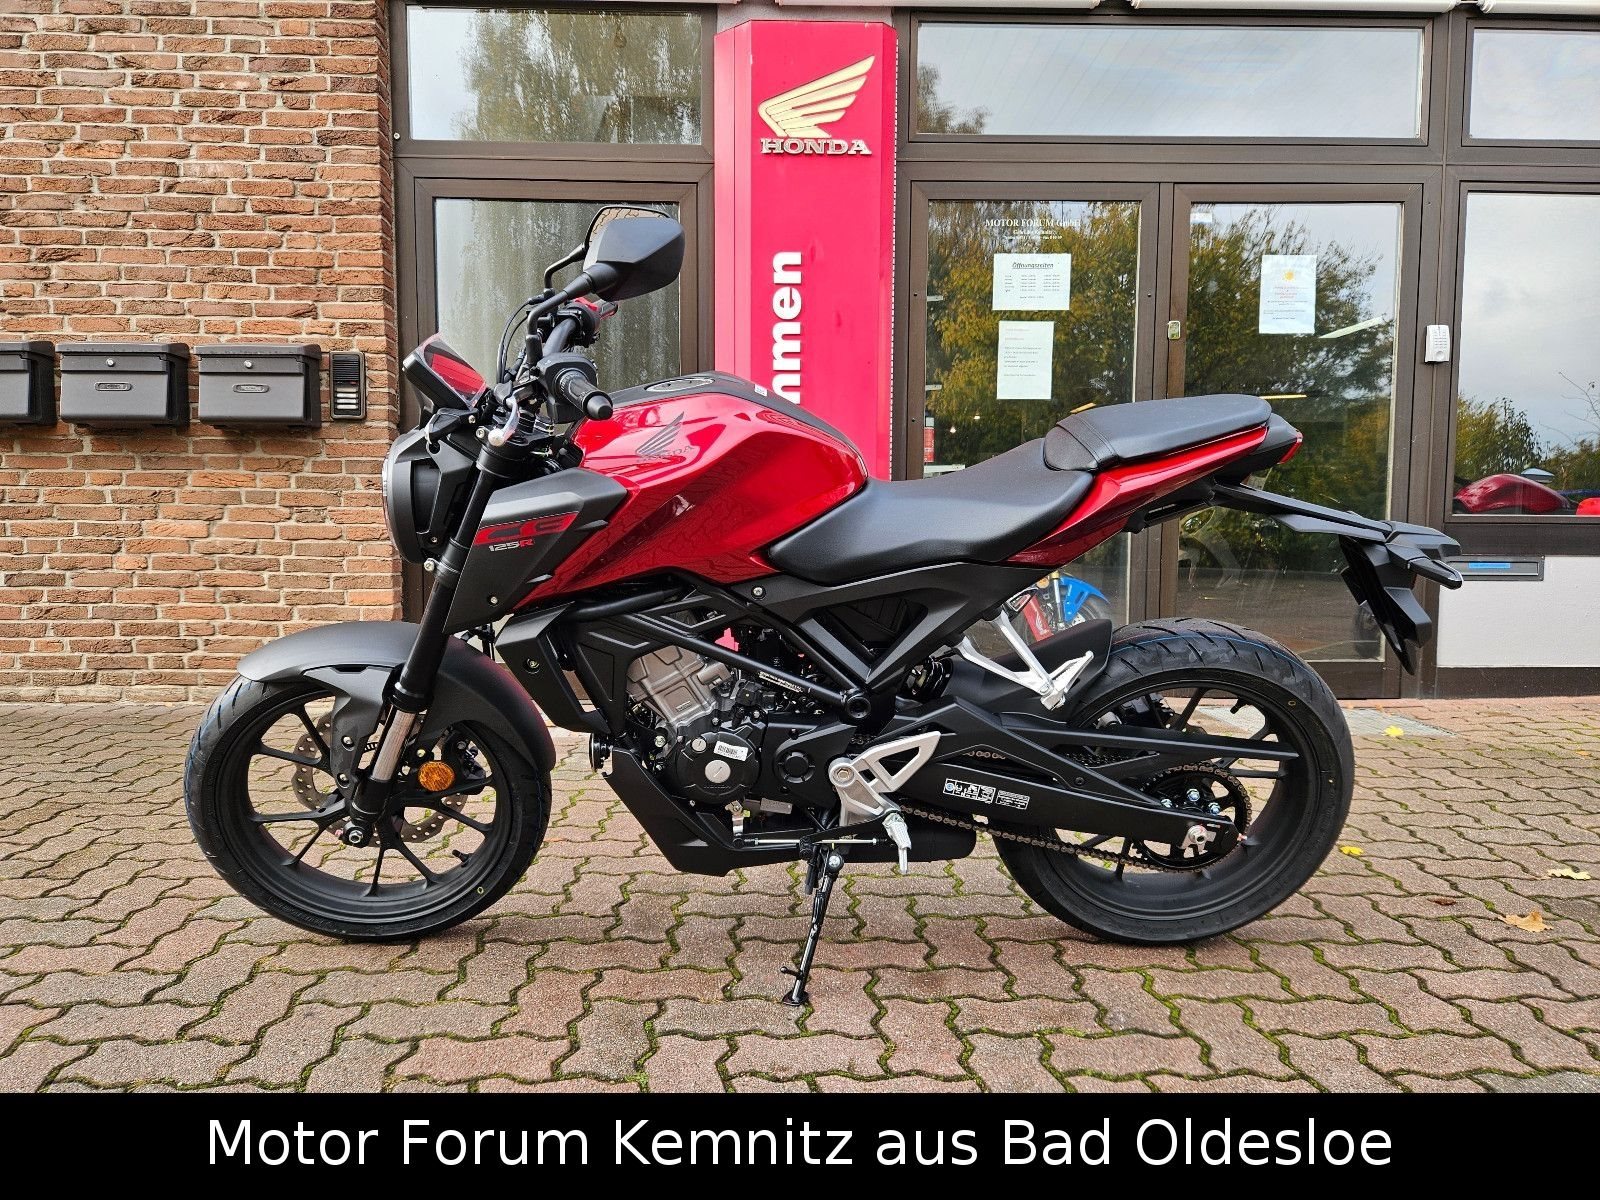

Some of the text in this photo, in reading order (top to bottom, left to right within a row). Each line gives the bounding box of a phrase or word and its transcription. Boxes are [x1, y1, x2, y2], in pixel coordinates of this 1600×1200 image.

[760, 138, 872, 155] HONDA
[985, 218, 1019, 227] MOTOR
[1021, 218, 1054, 227] FORUM
[1012, 261, 1054, 269] Öffnungszeiten
[488, 538, 535, 552] 125R
